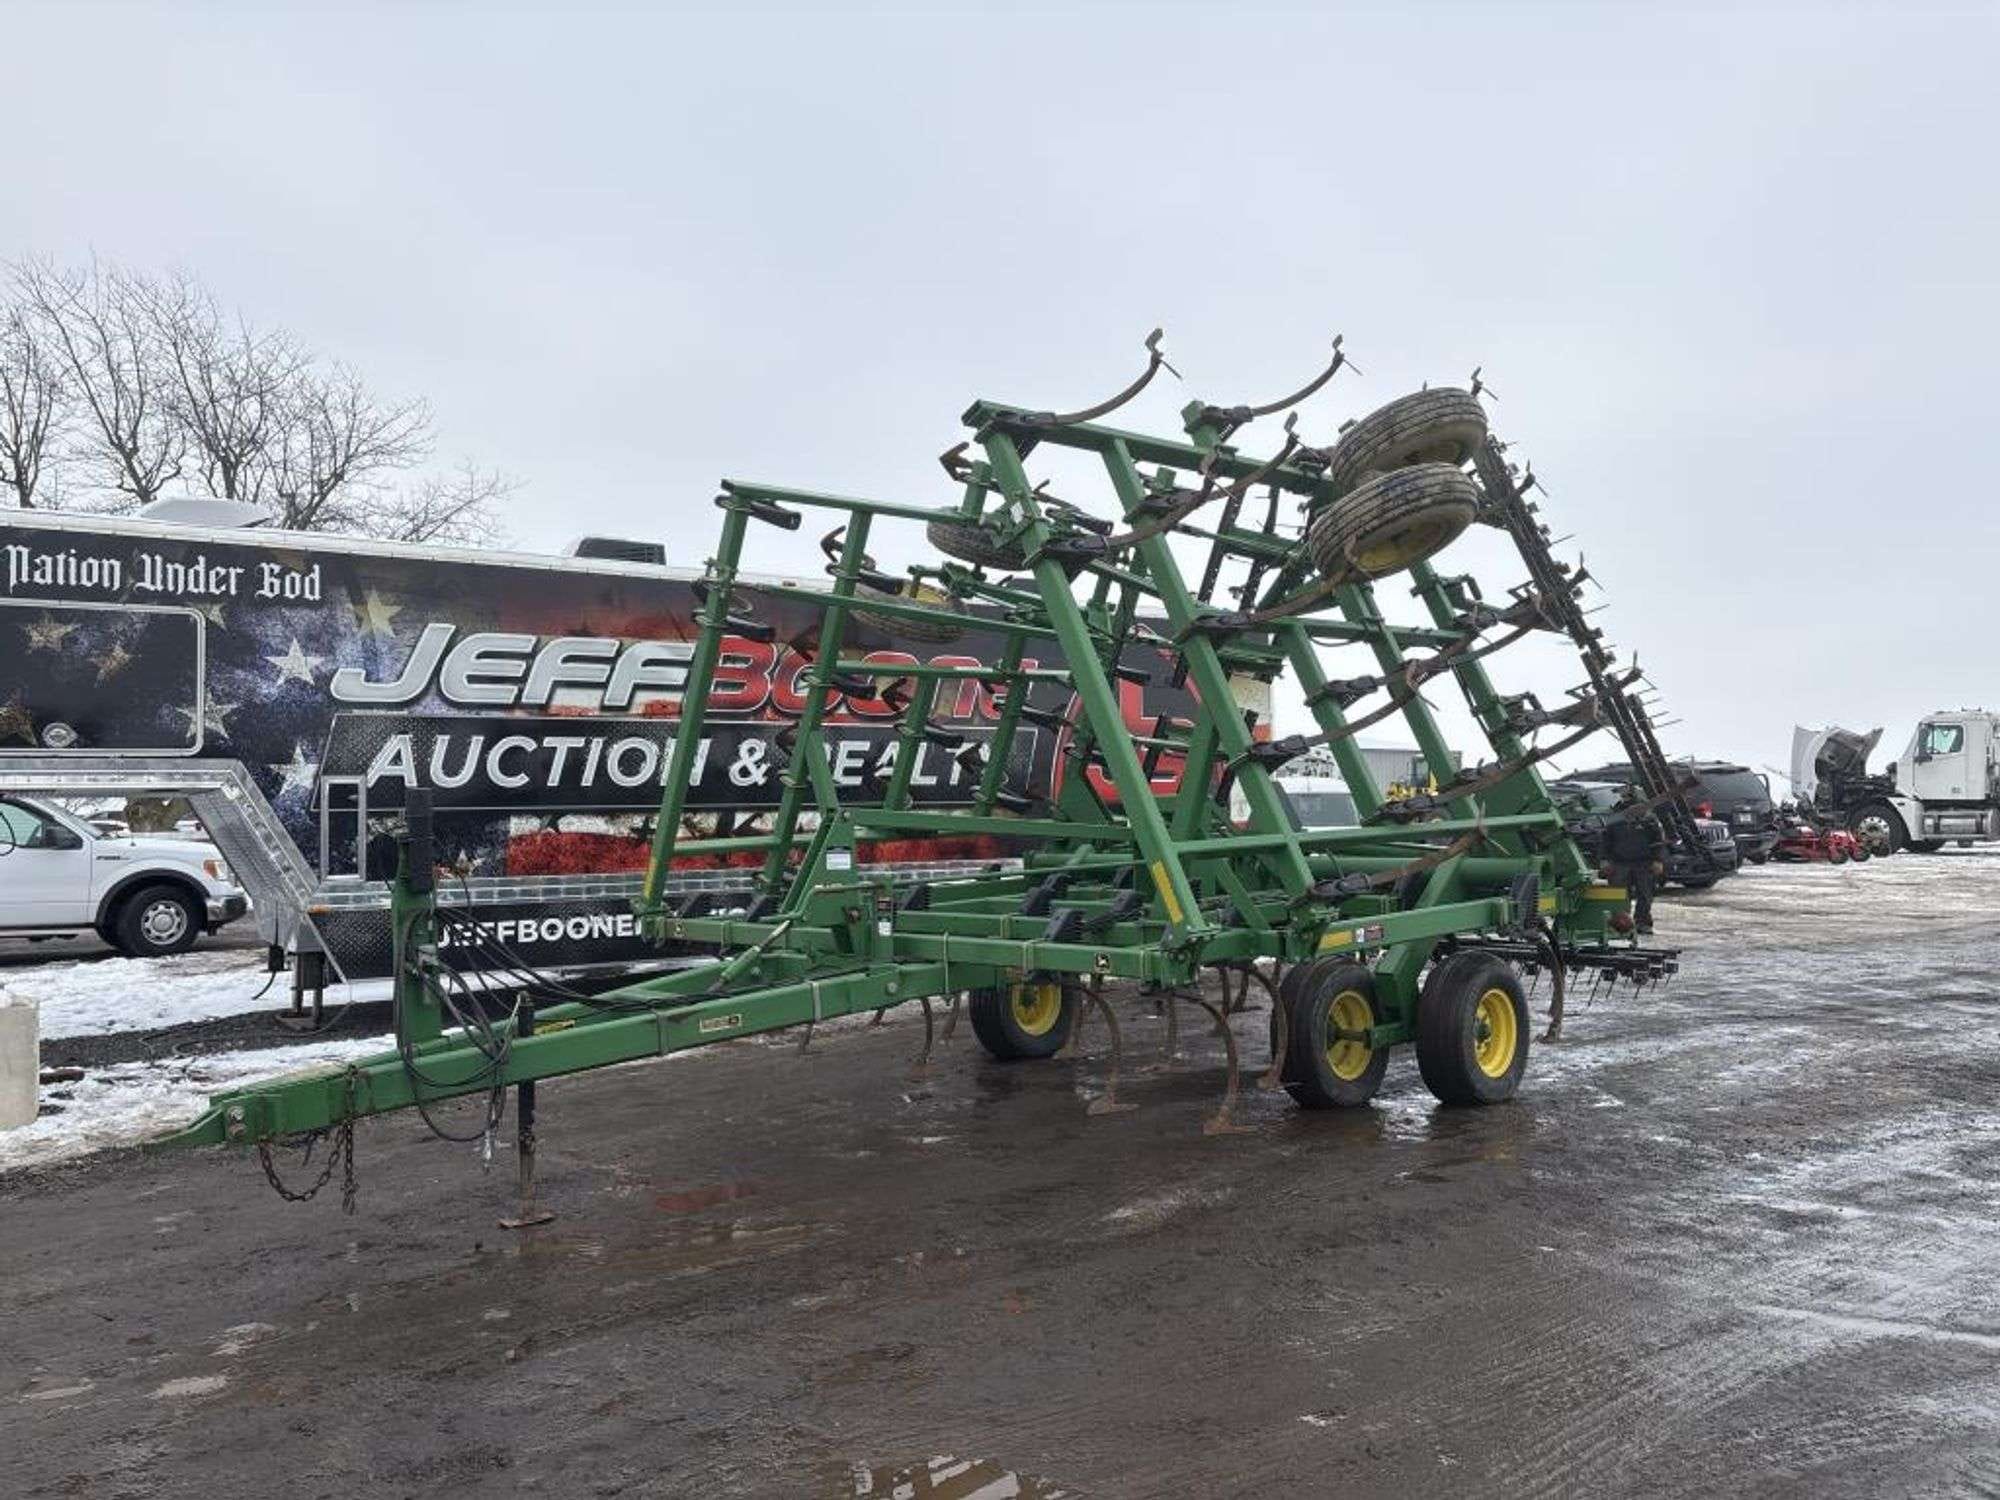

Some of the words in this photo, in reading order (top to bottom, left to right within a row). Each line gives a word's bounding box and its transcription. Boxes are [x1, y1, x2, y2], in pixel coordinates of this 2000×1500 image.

[1, 545, 121, 594] Nation
[134, 553, 245, 595] Under
[255, 562, 321, 601] God
[329, 622, 696, 706] JEFF
[728, 737, 769, 787] &
